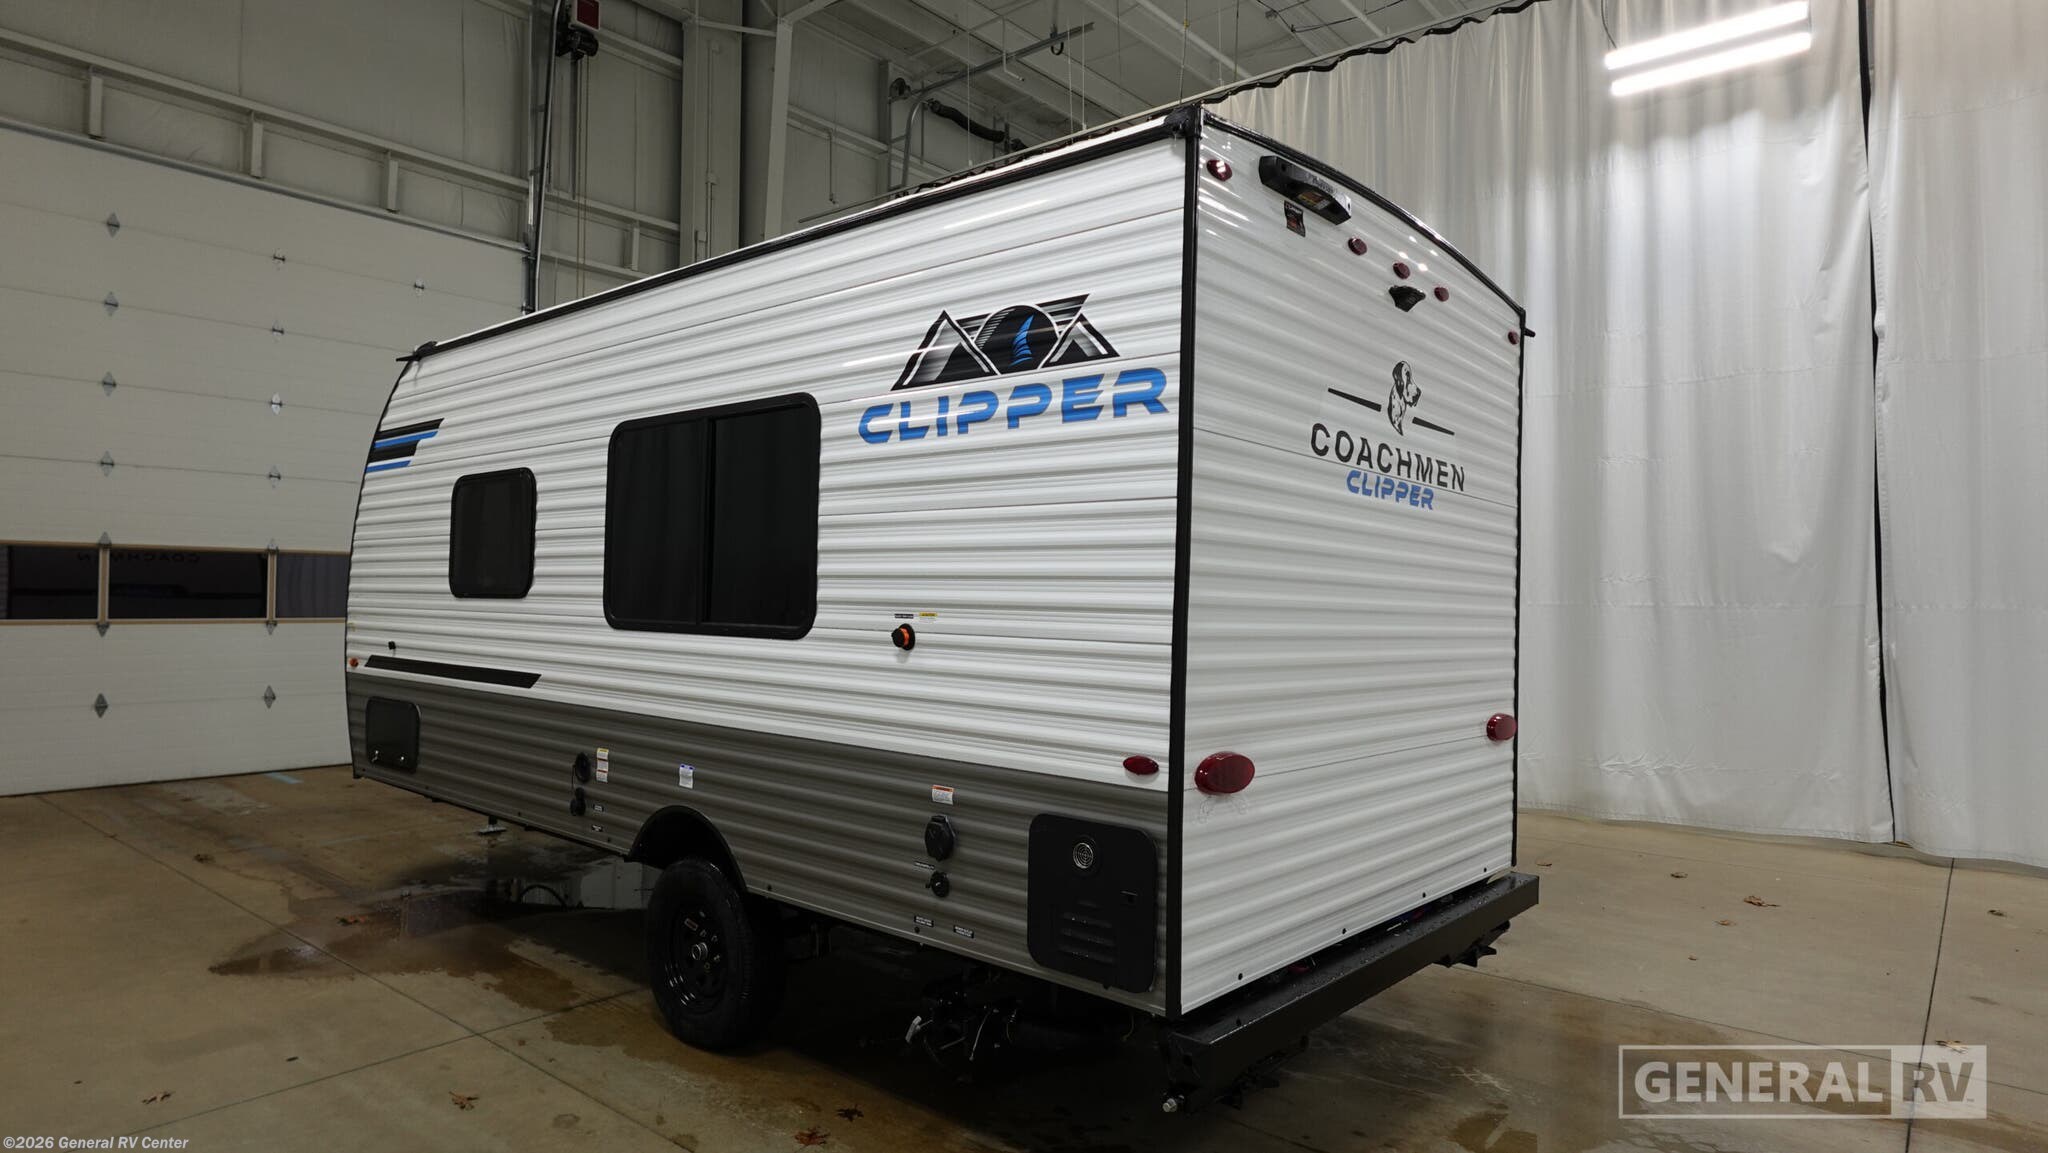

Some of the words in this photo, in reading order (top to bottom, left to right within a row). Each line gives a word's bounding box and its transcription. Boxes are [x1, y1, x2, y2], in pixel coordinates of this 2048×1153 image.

[858, 367, 1170, 444] CLIPPER
[1310, 423, 1465, 492] COACHMEN
[1346, 469, 1434, 510] CLIPPER
